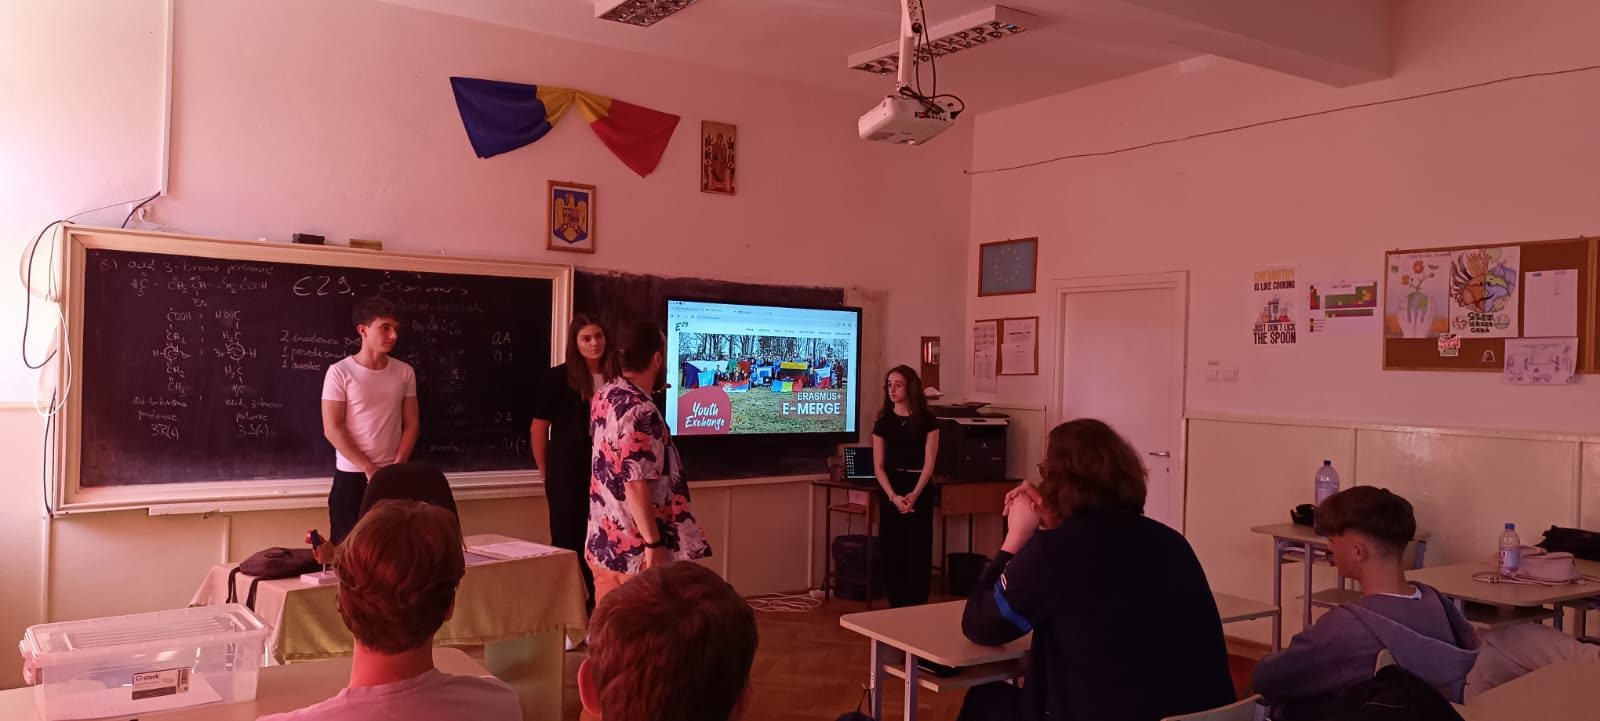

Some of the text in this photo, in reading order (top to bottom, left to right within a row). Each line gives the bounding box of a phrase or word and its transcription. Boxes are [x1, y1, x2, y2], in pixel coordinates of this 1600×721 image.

[1253, 331, 1296, 344] THE SPOON
[798, 392, 841, 400] ERASMUS+
[692, 402, 719, 417] Youth
[782, 402, 840, 415] E-MERGE
[685, 416, 725, 430] Exchange
